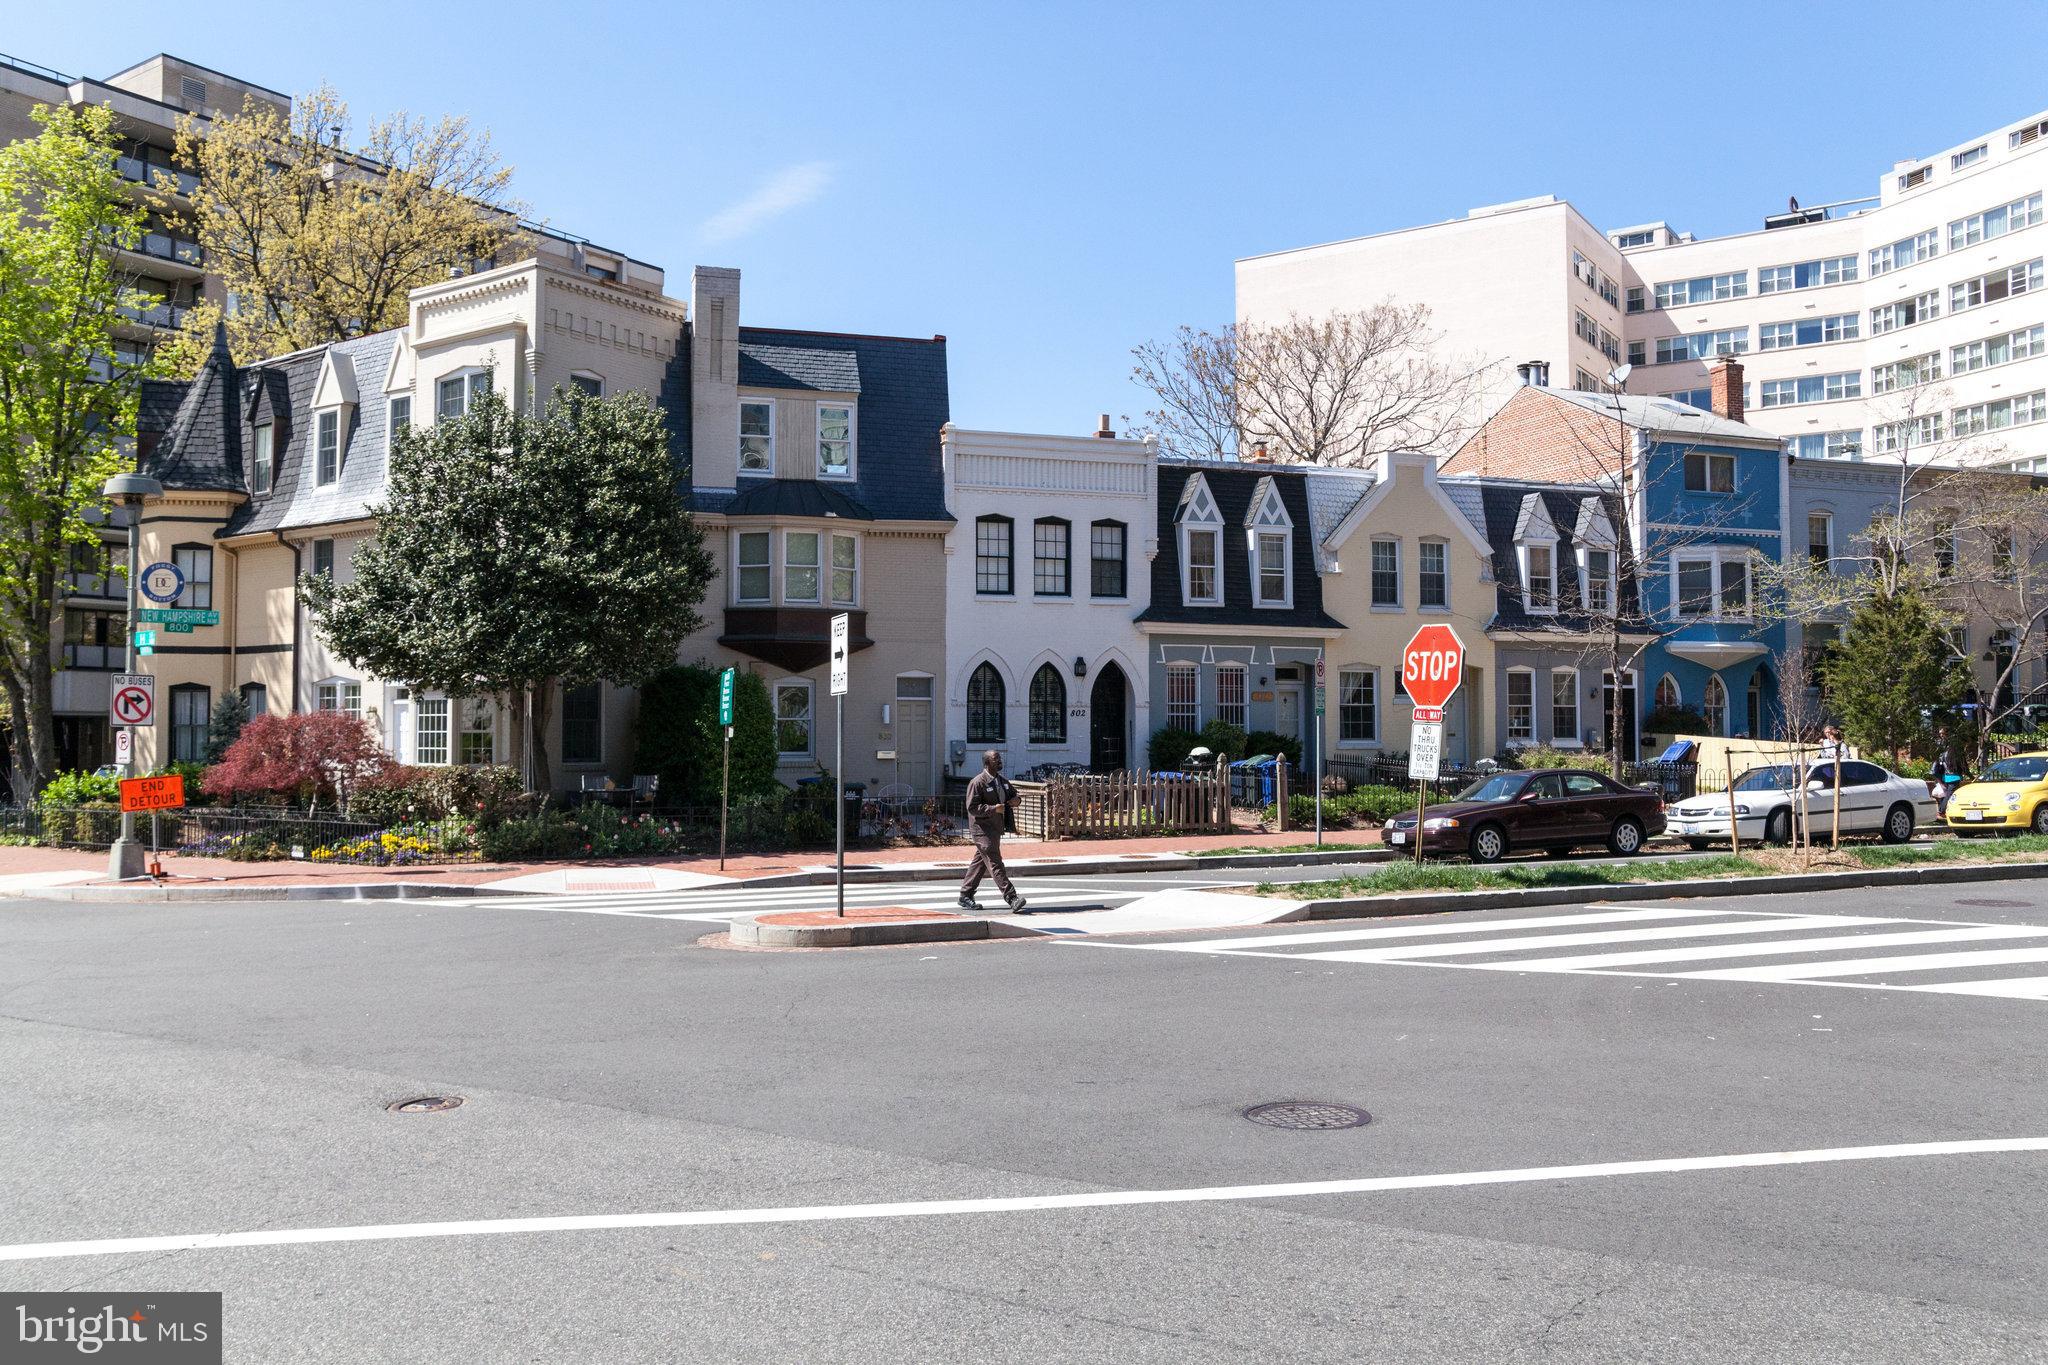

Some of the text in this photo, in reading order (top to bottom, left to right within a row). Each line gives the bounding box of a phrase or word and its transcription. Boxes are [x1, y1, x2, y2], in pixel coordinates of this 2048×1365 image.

[155, 577, 172, 588] DC
[141, 610, 159, 622] NEW
[162, 611, 206, 624] HAMPSHIRE
[169, 623, 189, 632] 800
[833, 621, 846, 637] KEEP
[1406, 650, 1458, 682] STOP
[114, 676, 152, 686] NO BUSES
[832, 671, 847, 688] RIGHT
[1070, 709, 1086, 717] 802
[1415, 710, 1441, 720] ALL WAY
[1422, 726, 1432, 735] NO
[1418, 735, 1436, 744] THRU
[1413, 744, 1438, 753] TRUCKS
[1416, 753, 1434, 762] OVER
[141, 780, 165, 793] END
[130, 793, 177, 808] DETOUR
